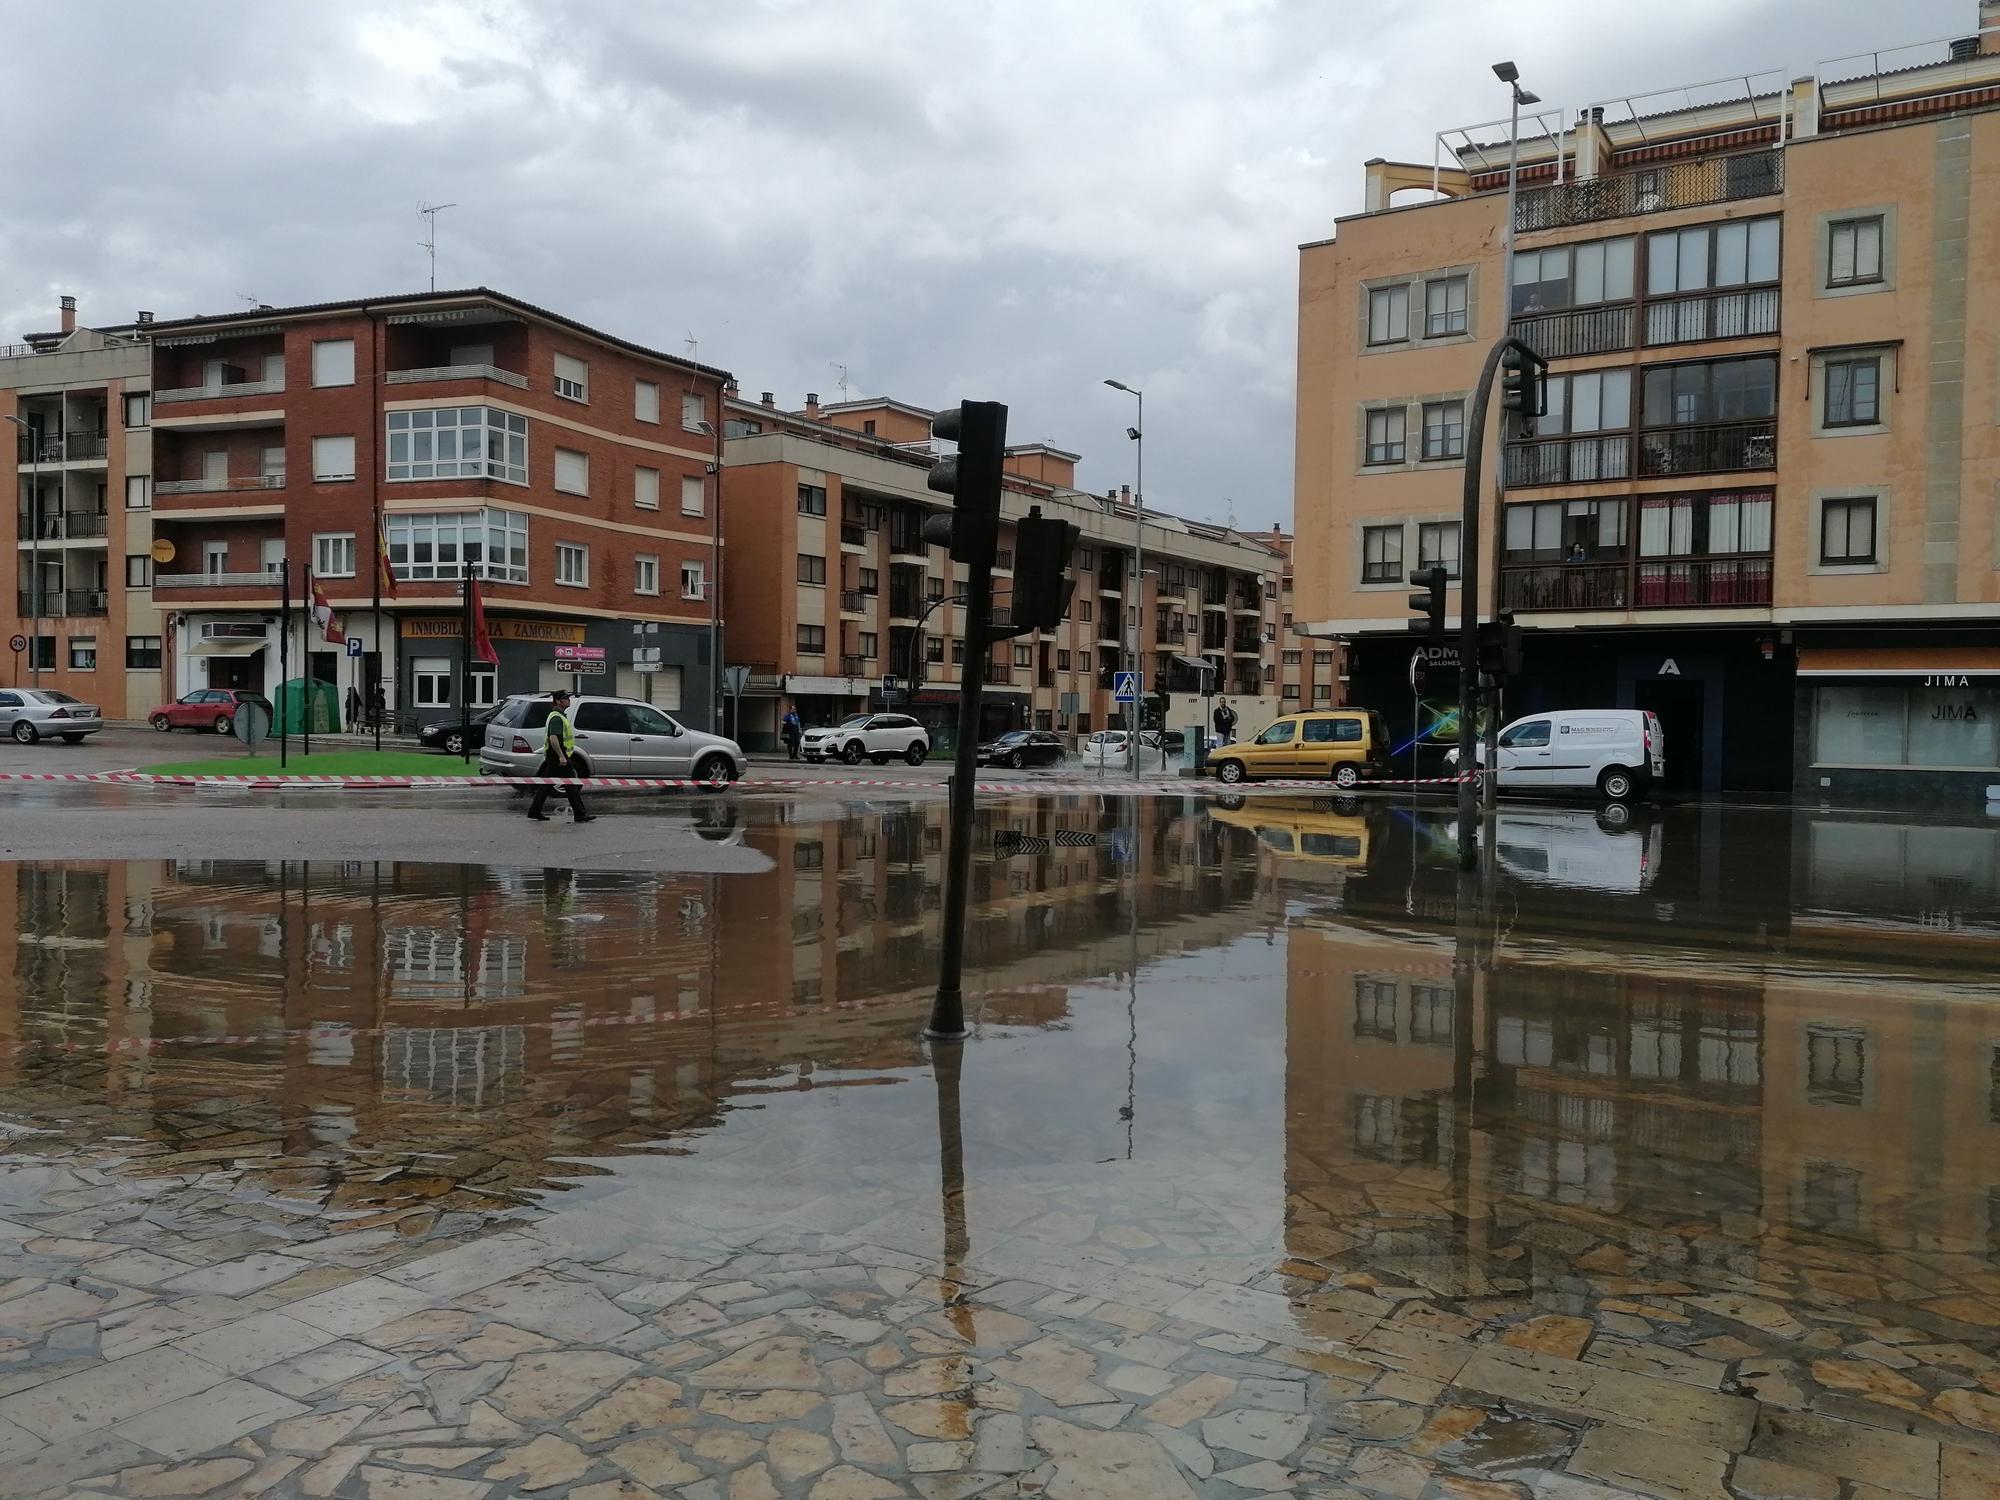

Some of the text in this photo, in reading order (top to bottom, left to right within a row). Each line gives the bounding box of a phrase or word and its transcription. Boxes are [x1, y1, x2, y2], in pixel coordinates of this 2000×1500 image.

[411, 621, 577, 641] INMOBILIIA ZAMORANA
[349, 639, 360, 655] P
[1411, 646, 1460, 660] ADM
[1657, 658, 1681, 675] A
[1924, 675, 1969, 687] JIMA
[1931, 705, 1977, 720] JIMA
